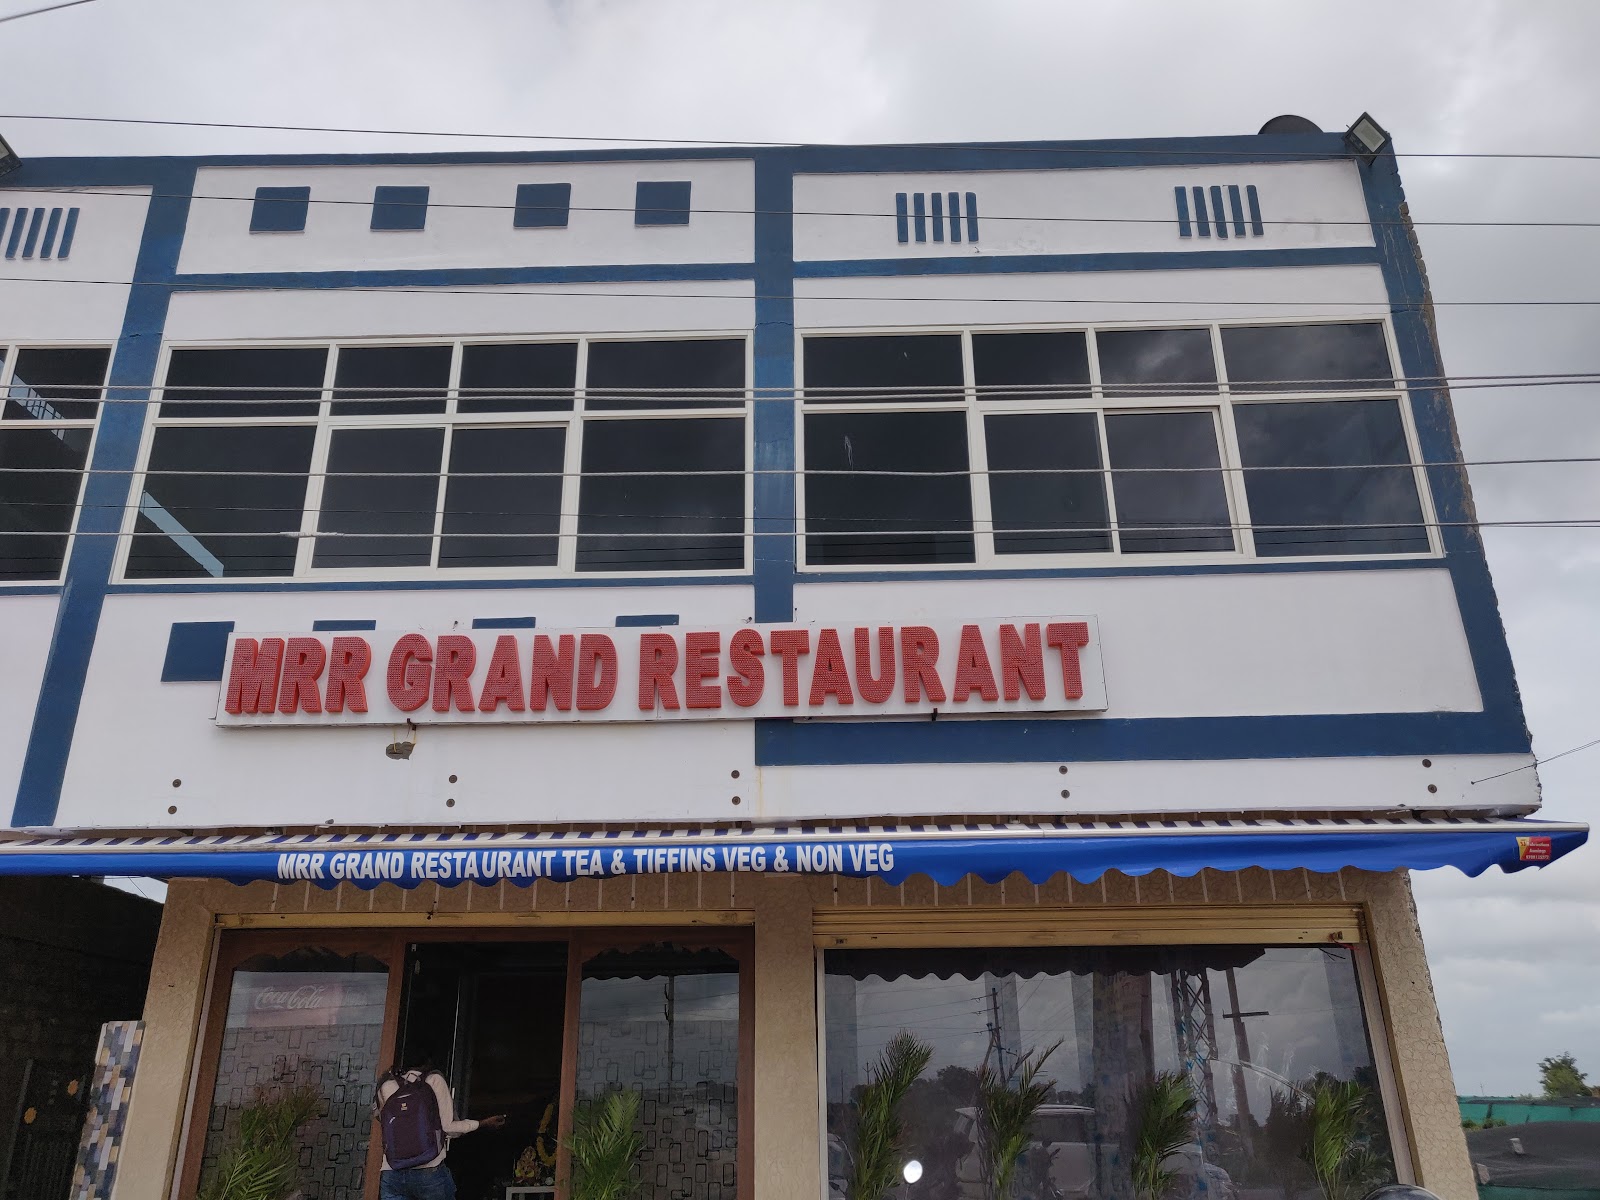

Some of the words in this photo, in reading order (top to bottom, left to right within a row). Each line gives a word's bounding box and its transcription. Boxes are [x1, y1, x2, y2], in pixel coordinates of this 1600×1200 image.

[225, 636, 372, 715] MRR
[387, 633, 618, 712] GRAND
[638, 622, 1089, 711] RESTAURANT
[277, 853, 325, 879] MRR
[330, 852, 404, 879] GRAND
[411, 850, 556, 878] RESTAURANT
[562, 849, 605, 876] TEA
[611, 849, 627, 875] &
[633, 848, 716, 873] TIFFINS
[722, 846, 767, 871] VEG
[773, 845, 789, 871] &
[797, 845, 843, 872] NON
[849, 844, 894, 872] VEG
